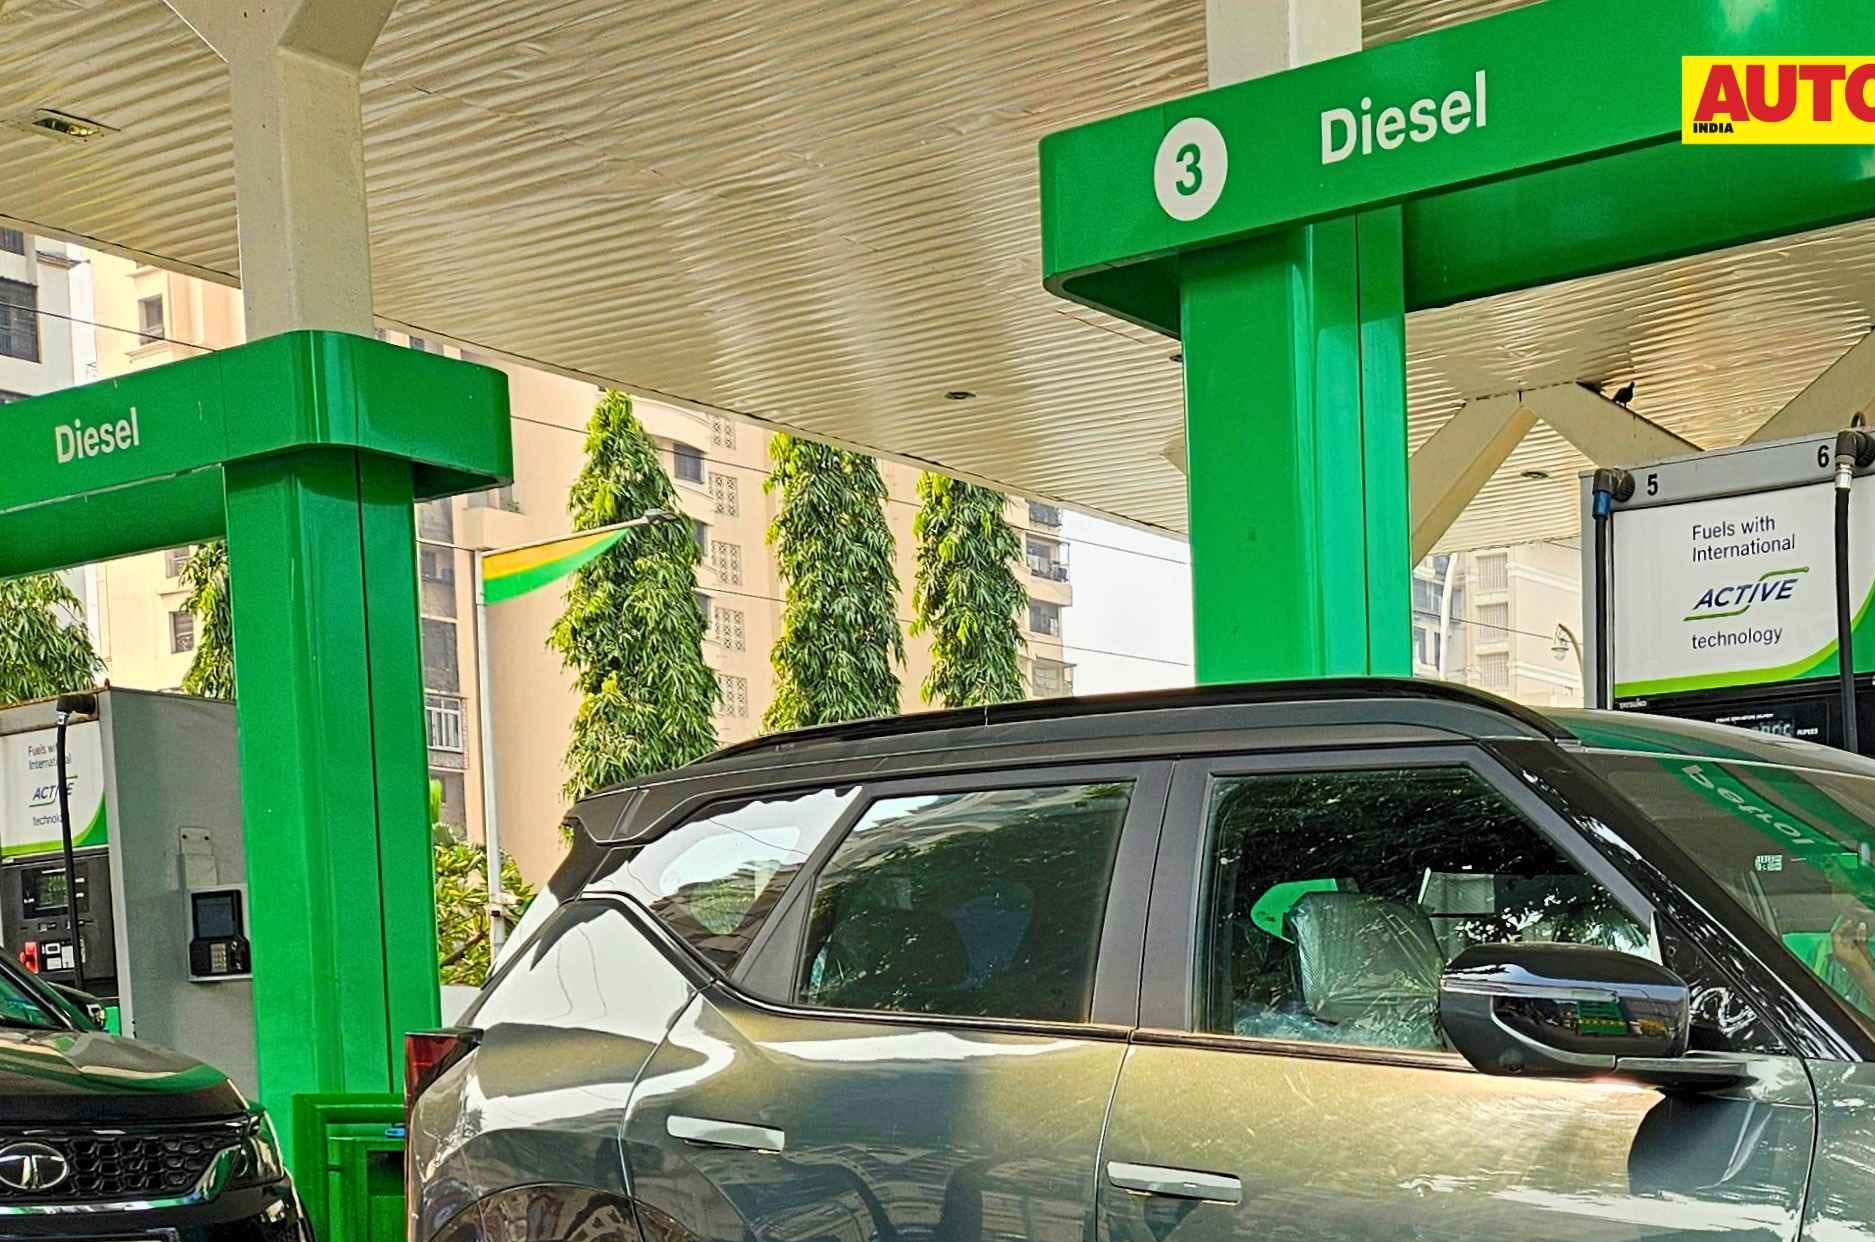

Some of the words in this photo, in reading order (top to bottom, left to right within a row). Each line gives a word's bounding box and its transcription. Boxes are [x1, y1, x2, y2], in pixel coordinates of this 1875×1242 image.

[1320, 70, 1487, 165] Diesel
[1174, 143, 1203, 196] 3
[55, 408, 140, 465] Diesel
[1817, 445, 1830, 468] 6
[1647, 473, 1659, 496] 5
[1692, 520, 1735, 541] Fuels
[1741, 515, 1776, 535] with
[1692, 533, 1796, 563] International
[1692, 577, 1799, 610] ACTIVE
[1692, 626, 1784, 650] technology
